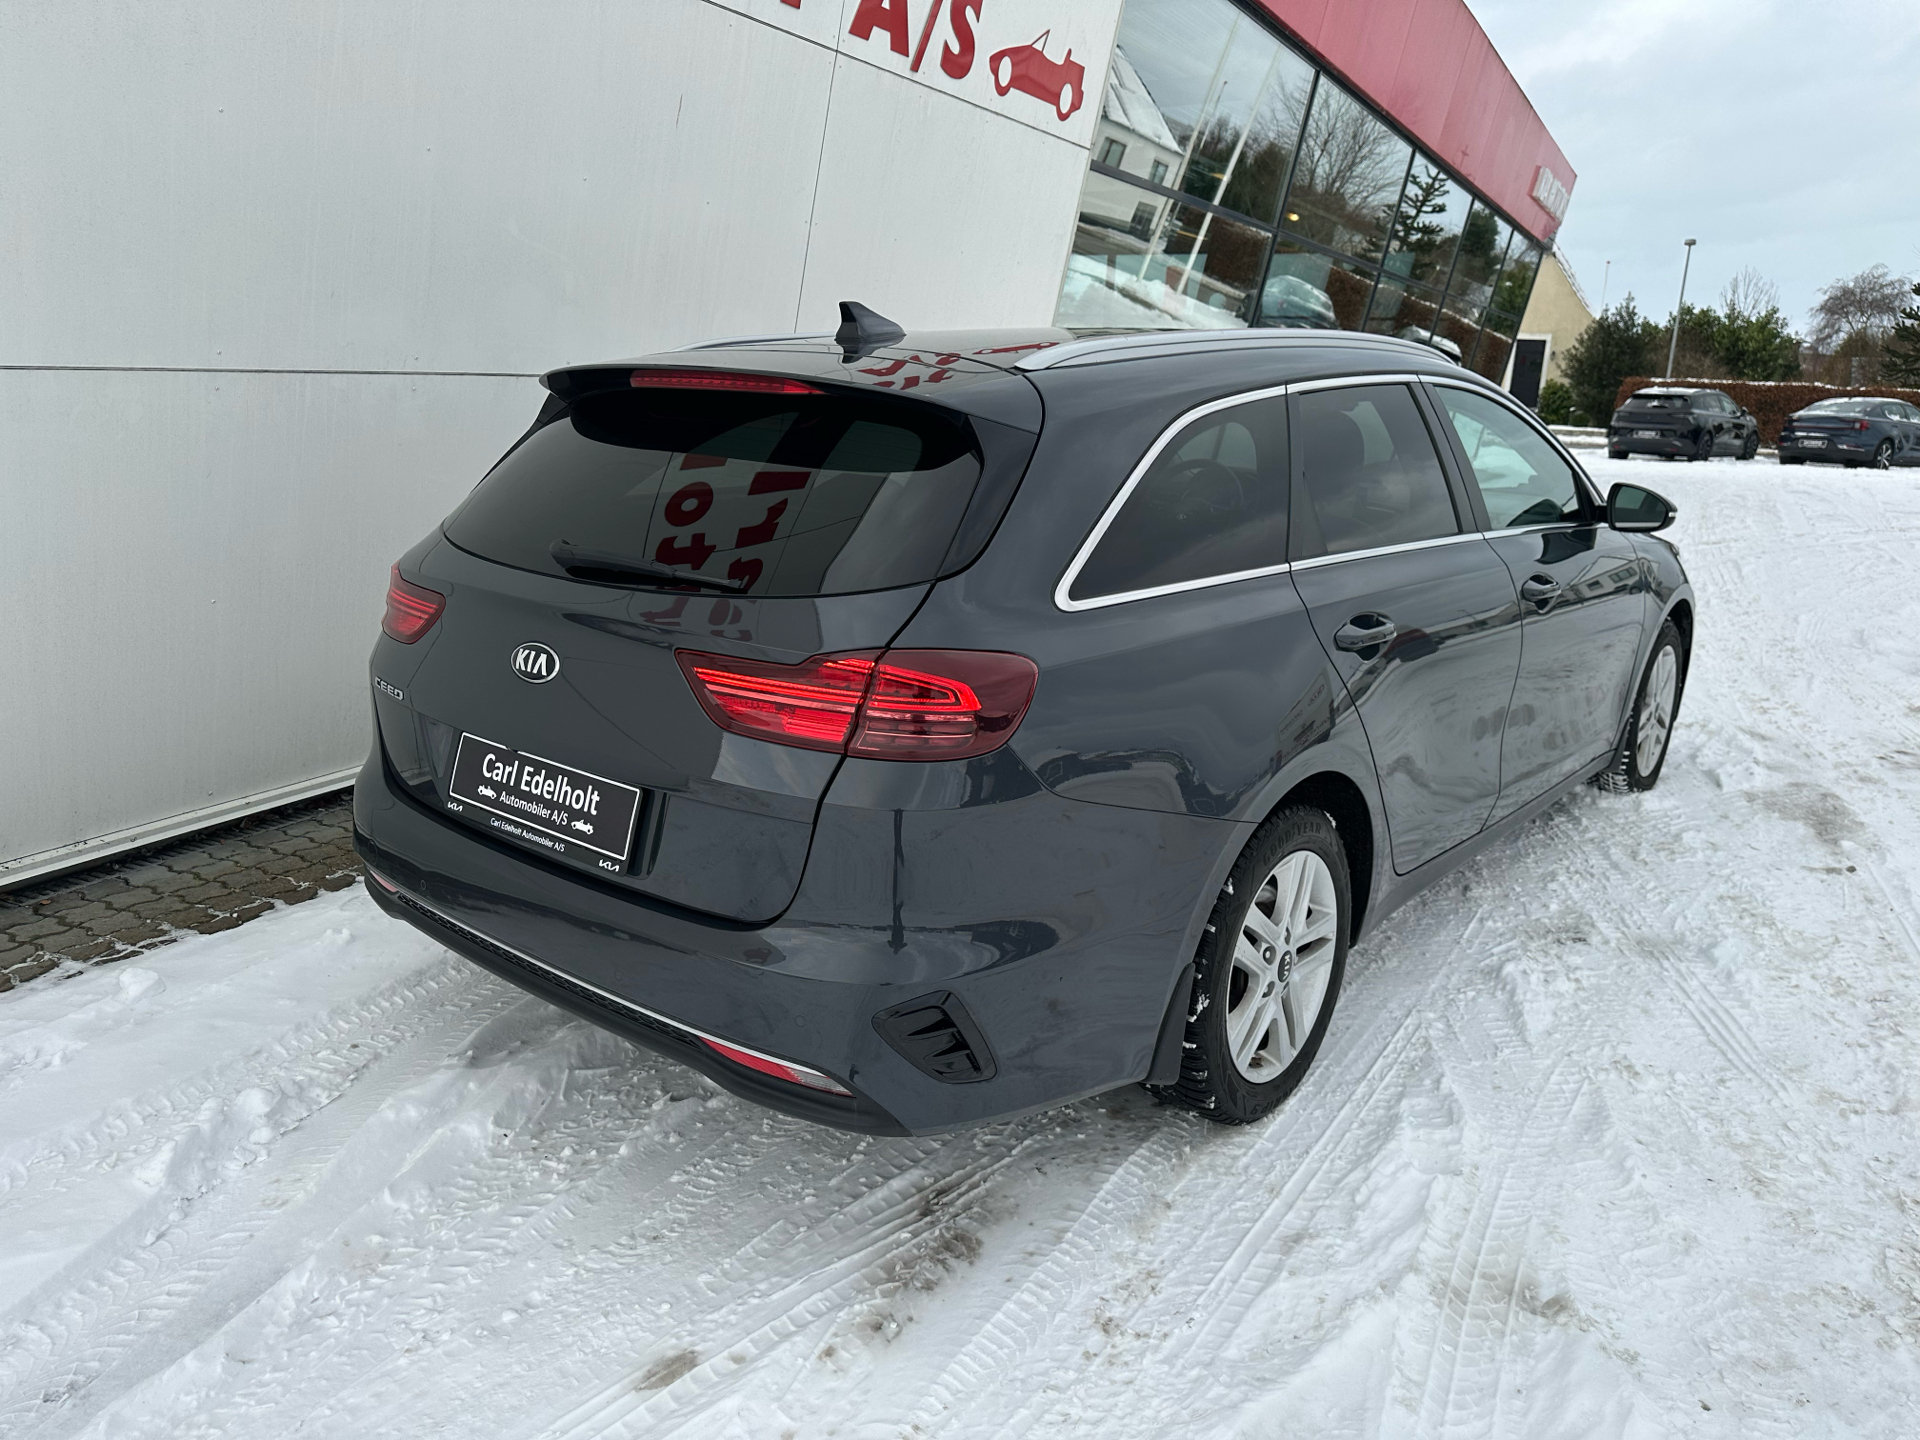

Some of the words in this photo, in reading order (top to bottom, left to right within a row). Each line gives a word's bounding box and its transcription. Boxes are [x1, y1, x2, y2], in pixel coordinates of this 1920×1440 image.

[848, 0, 983, 79] A/S
[515, 648, 548, 676] KIA
[374, 676, 404, 701] CEED
[482, 753, 519, 787] Carl
[520, 765, 600, 815] Edelholt
[447, 801, 463, 812] KIA
[499, 791, 551, 819] Automobiler
[551, 810, 569, 826] A/S
[490, 817, 502, 829] Carl
[501, 822, 522, 836] Edelholt
[522, 829, 554, 848] Automobiler
[553, 840, 565, 852] A/S
[599, 859, 620, 872] KIA
